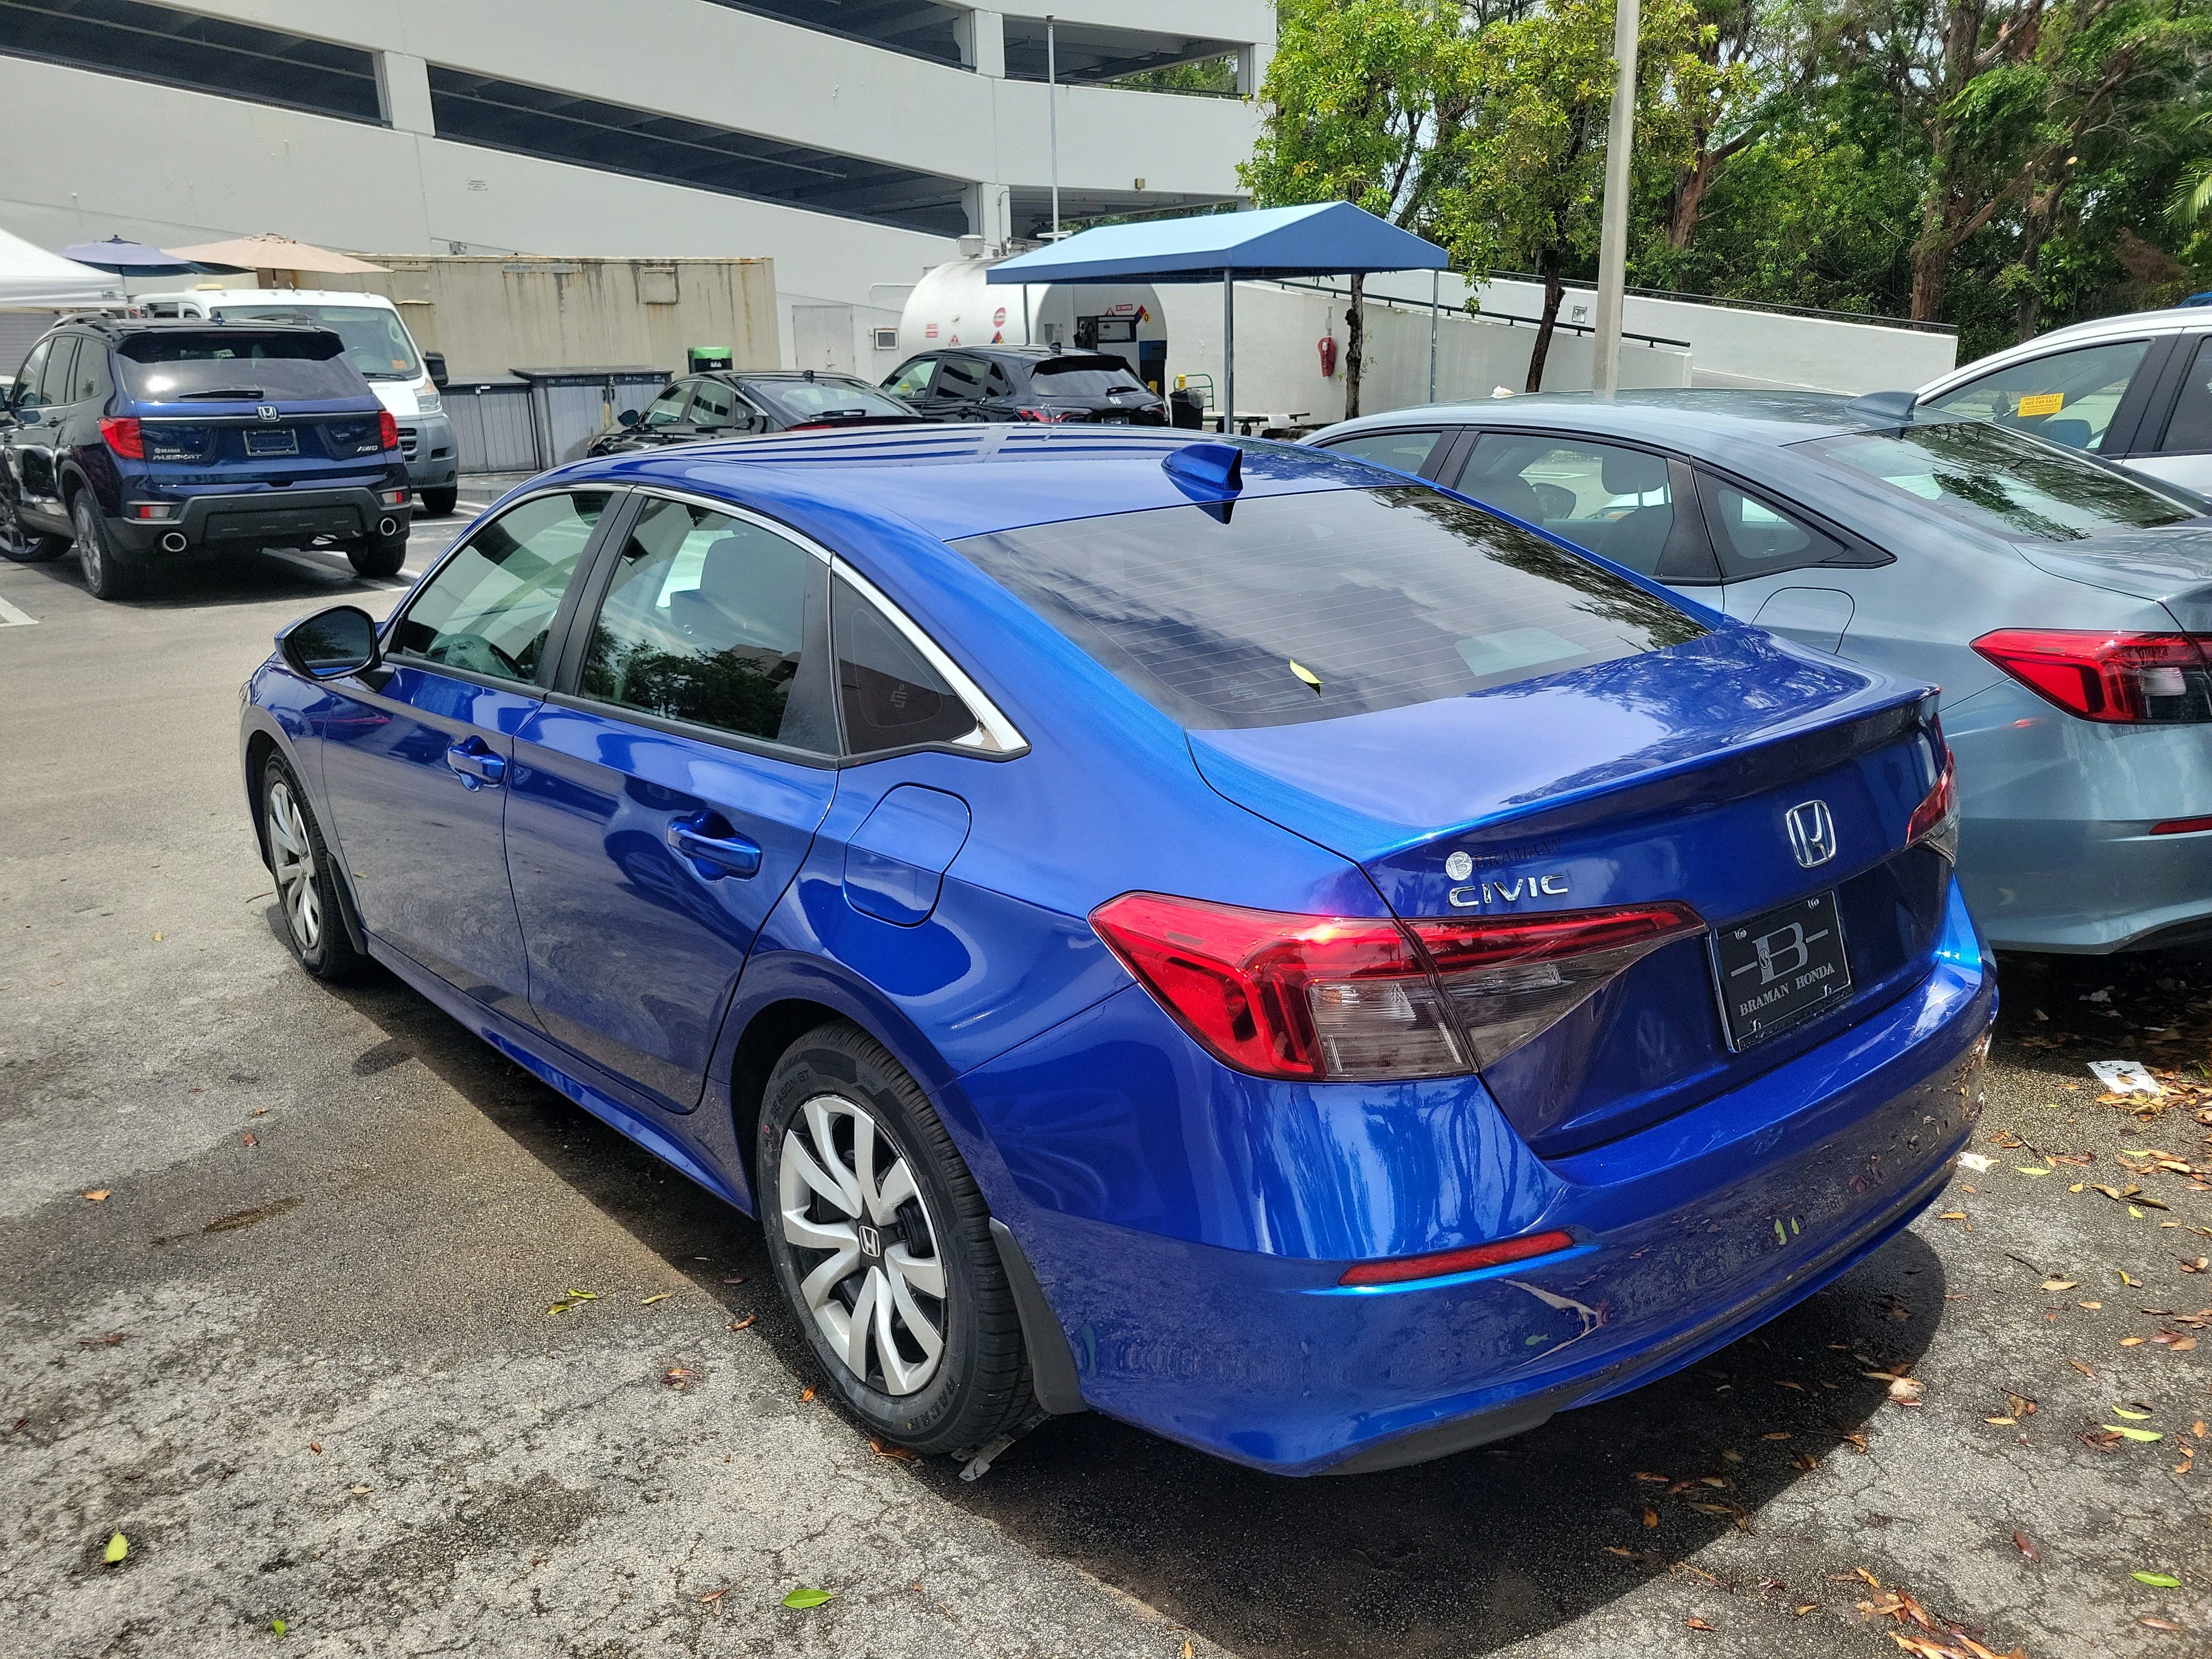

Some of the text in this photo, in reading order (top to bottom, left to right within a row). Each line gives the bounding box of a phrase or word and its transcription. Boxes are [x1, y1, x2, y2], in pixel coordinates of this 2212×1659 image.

[1449, 873, 1568, 907] CIVIC
[1739, 962, 1835, 1017] BRAMAN HONDA
